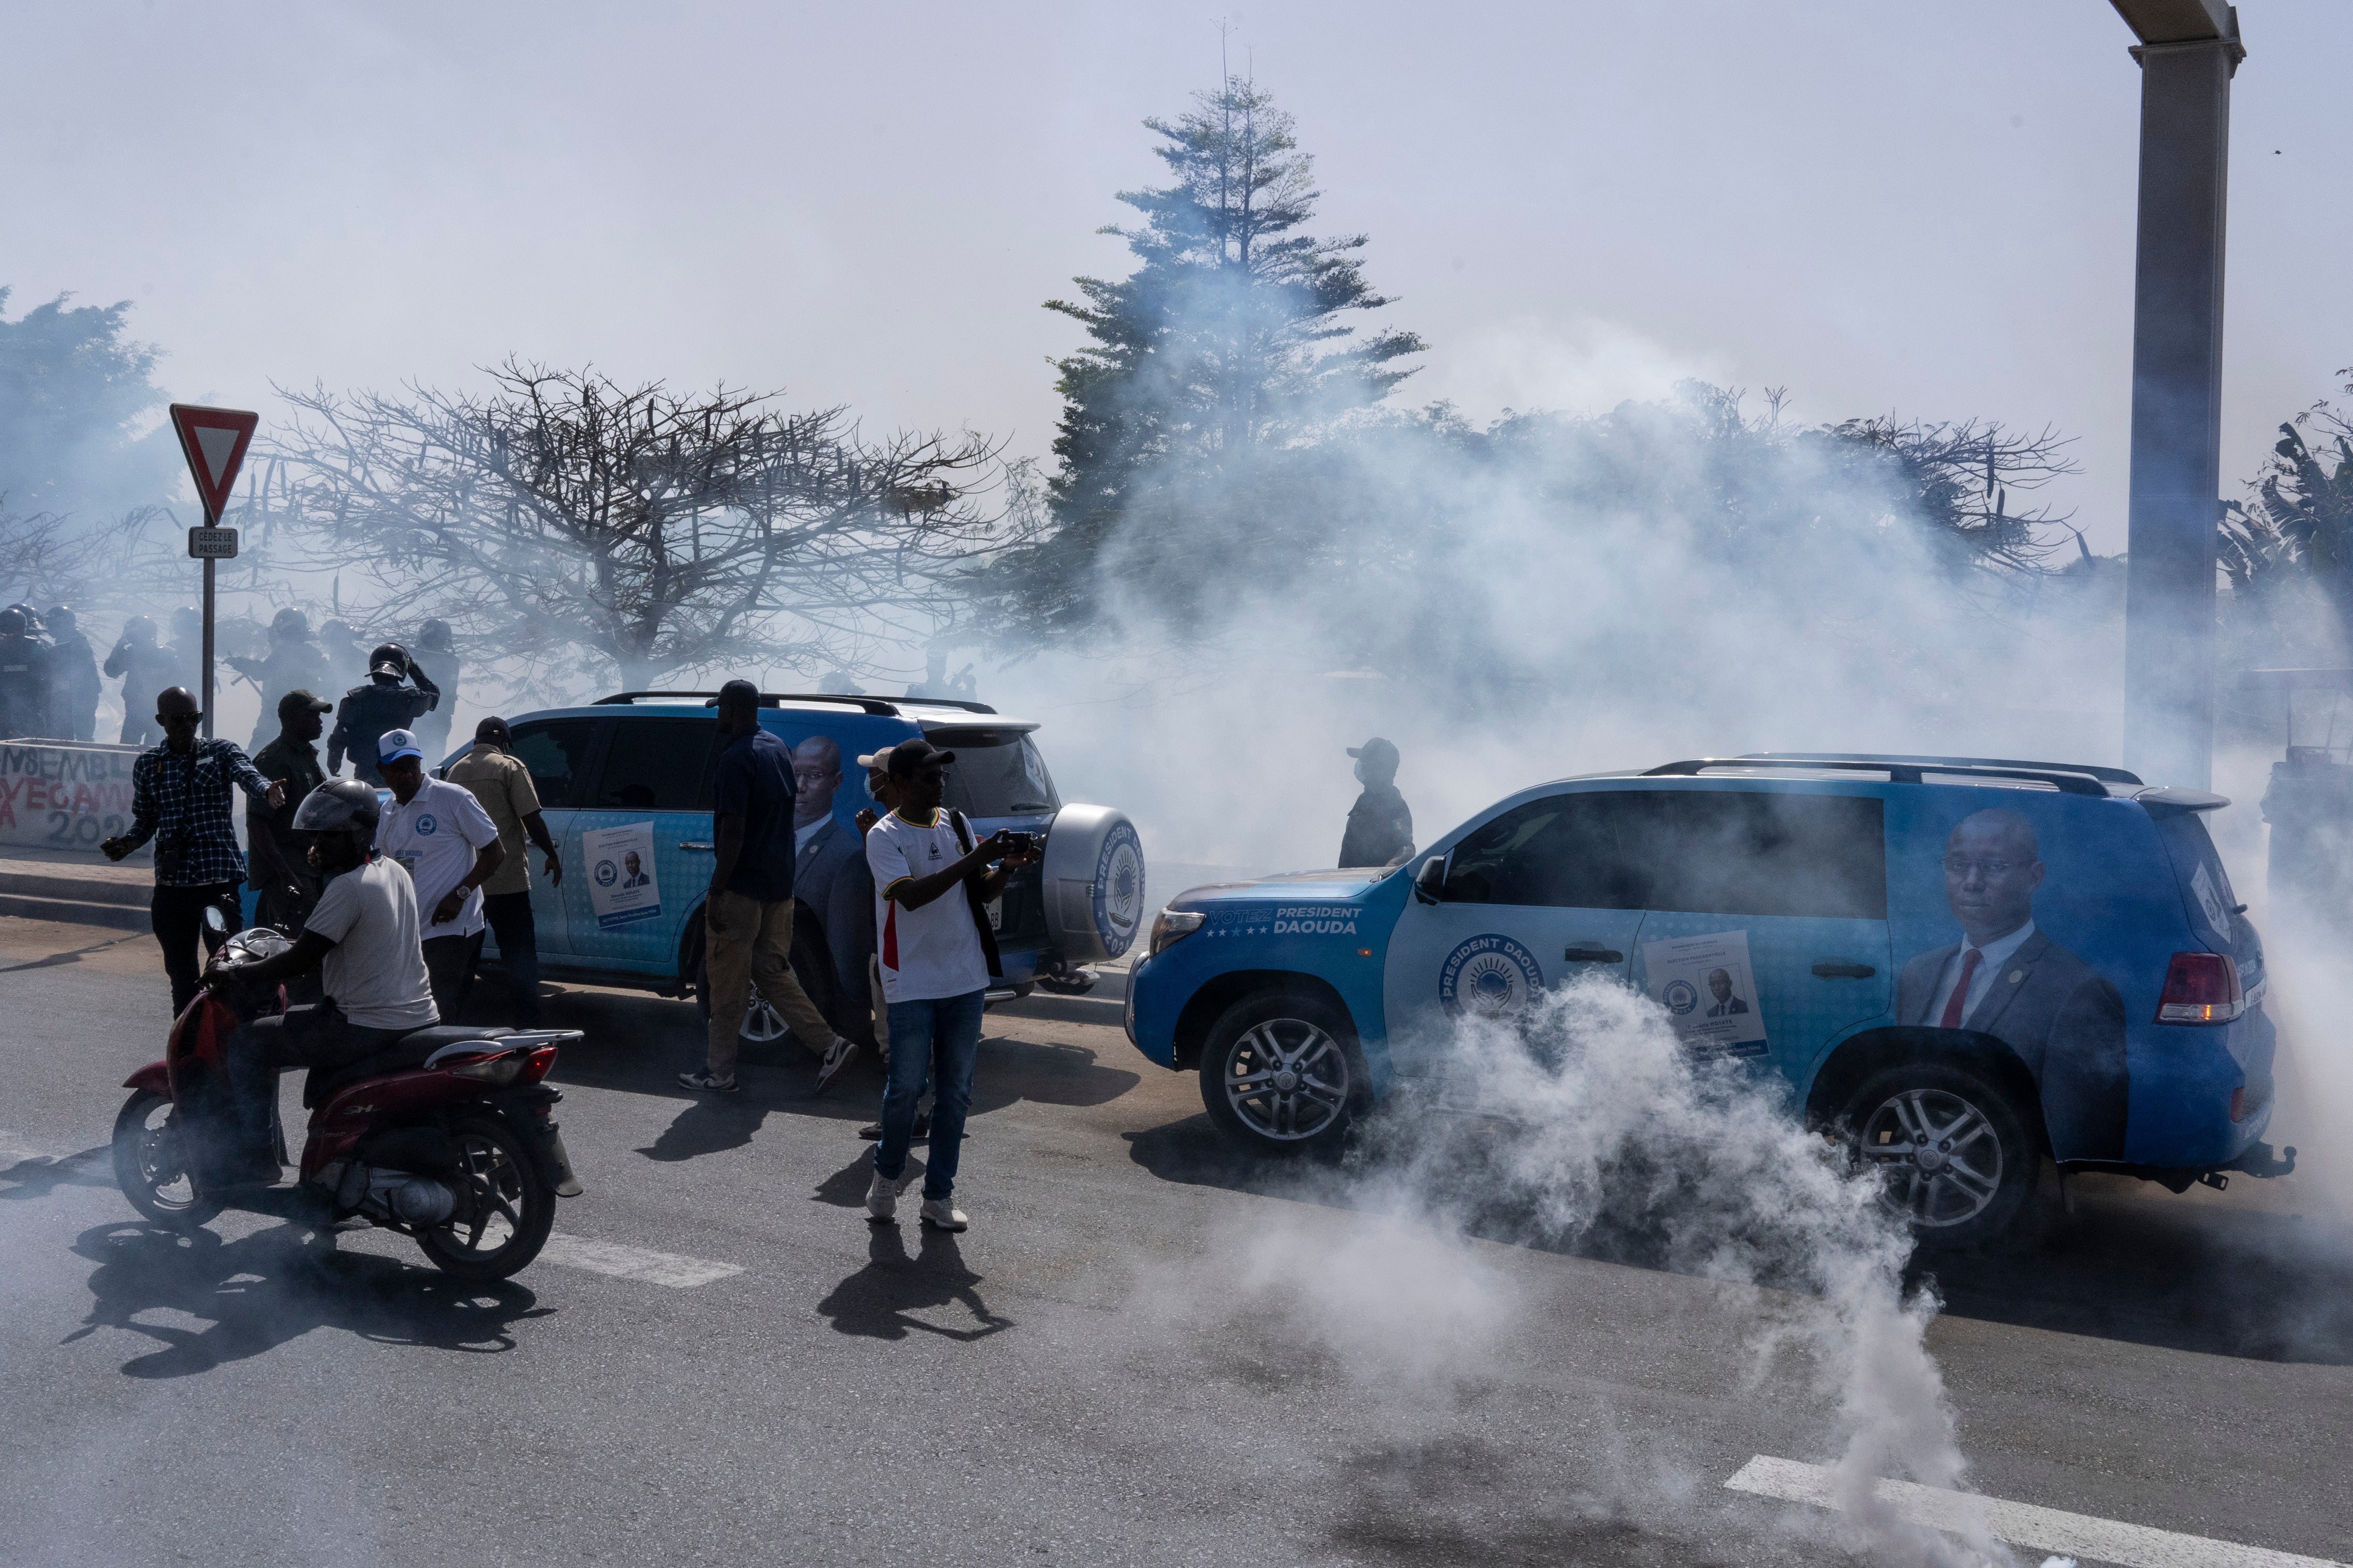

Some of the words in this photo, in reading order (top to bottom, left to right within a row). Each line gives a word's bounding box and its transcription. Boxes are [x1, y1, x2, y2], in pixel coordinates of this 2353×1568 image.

[199, 530, 222, 541] CÉDEZ
[224, 532, 232, 541] LE
[199, 544, 232, 554] PASSAGE
[1097, 825, 1131, 890] PRESIDENT
[1133, 837, 1145, 908] DAOUDA
[1209, 908, 1273, 925] VOTEZ
[1276, 907, 1362, 918] PRESIDENT
[1274, 921, 1357, 935] DAOUDA
[1443, 938, 1499, 997] PRESIDENT
